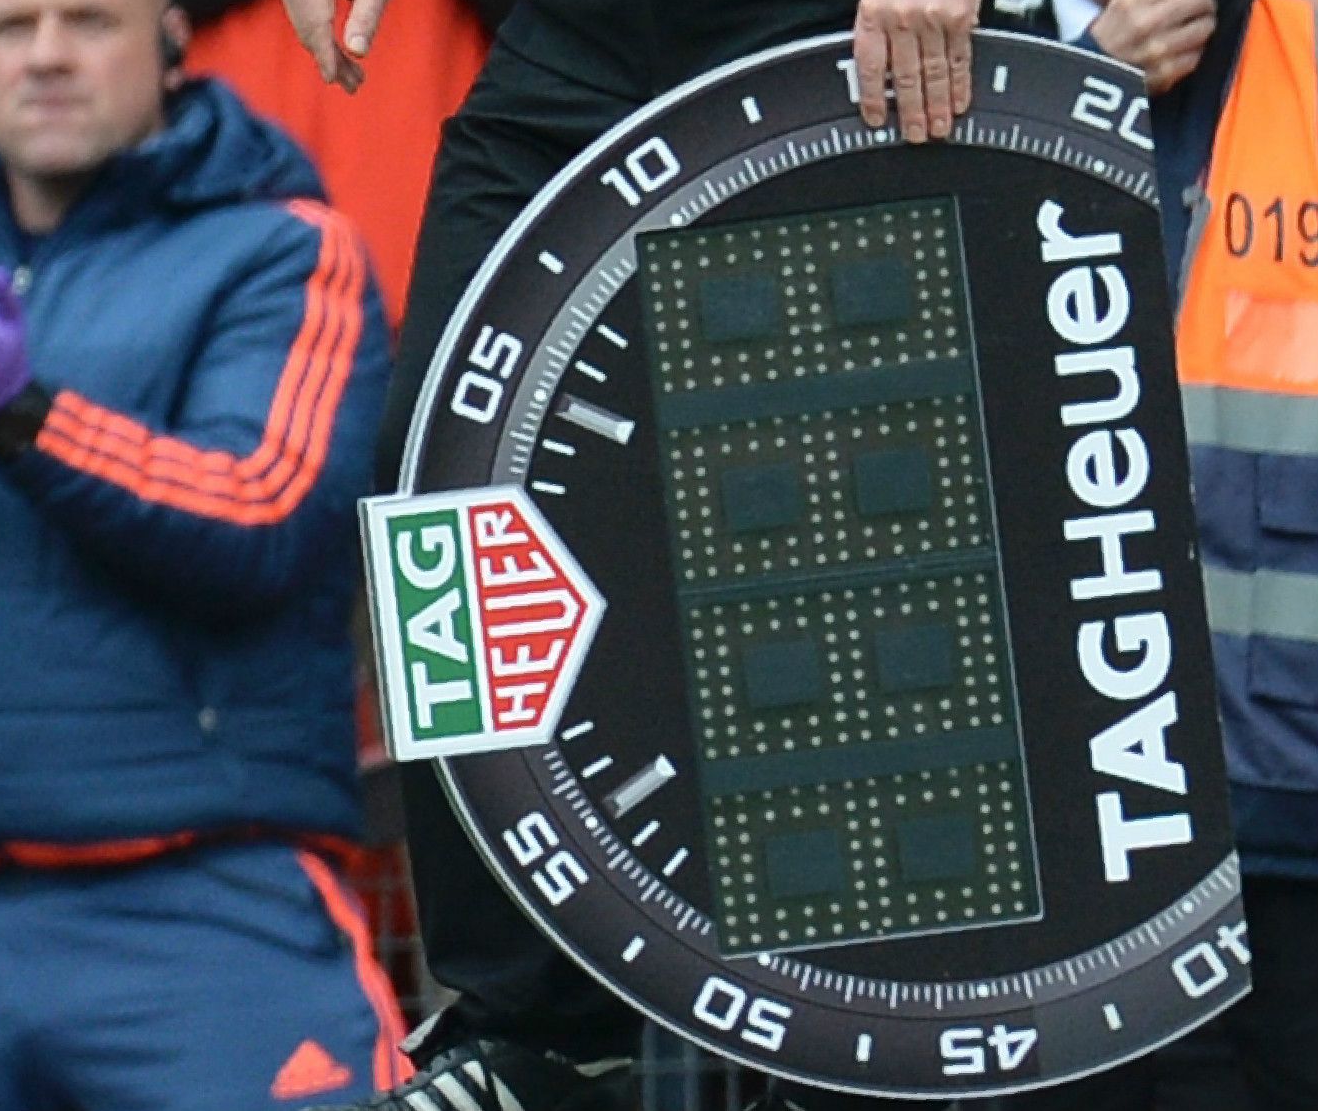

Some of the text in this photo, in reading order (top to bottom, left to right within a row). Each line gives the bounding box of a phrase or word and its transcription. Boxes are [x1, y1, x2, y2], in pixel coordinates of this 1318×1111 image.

[601, 136, 681, 207] 10
[1225, 192, 1318, 268] 019
[450, 324, 524, 425] 05
[1036, 199, 1193, 883] TAGHeuer
[396, 524, 474, 729] TAG
[474, 510, 580, 724] HEUER
[501, 811, 590, 907] 55
[692, 975, 794, 1052] 50
[939, 1023, 1038, 1077] 45
